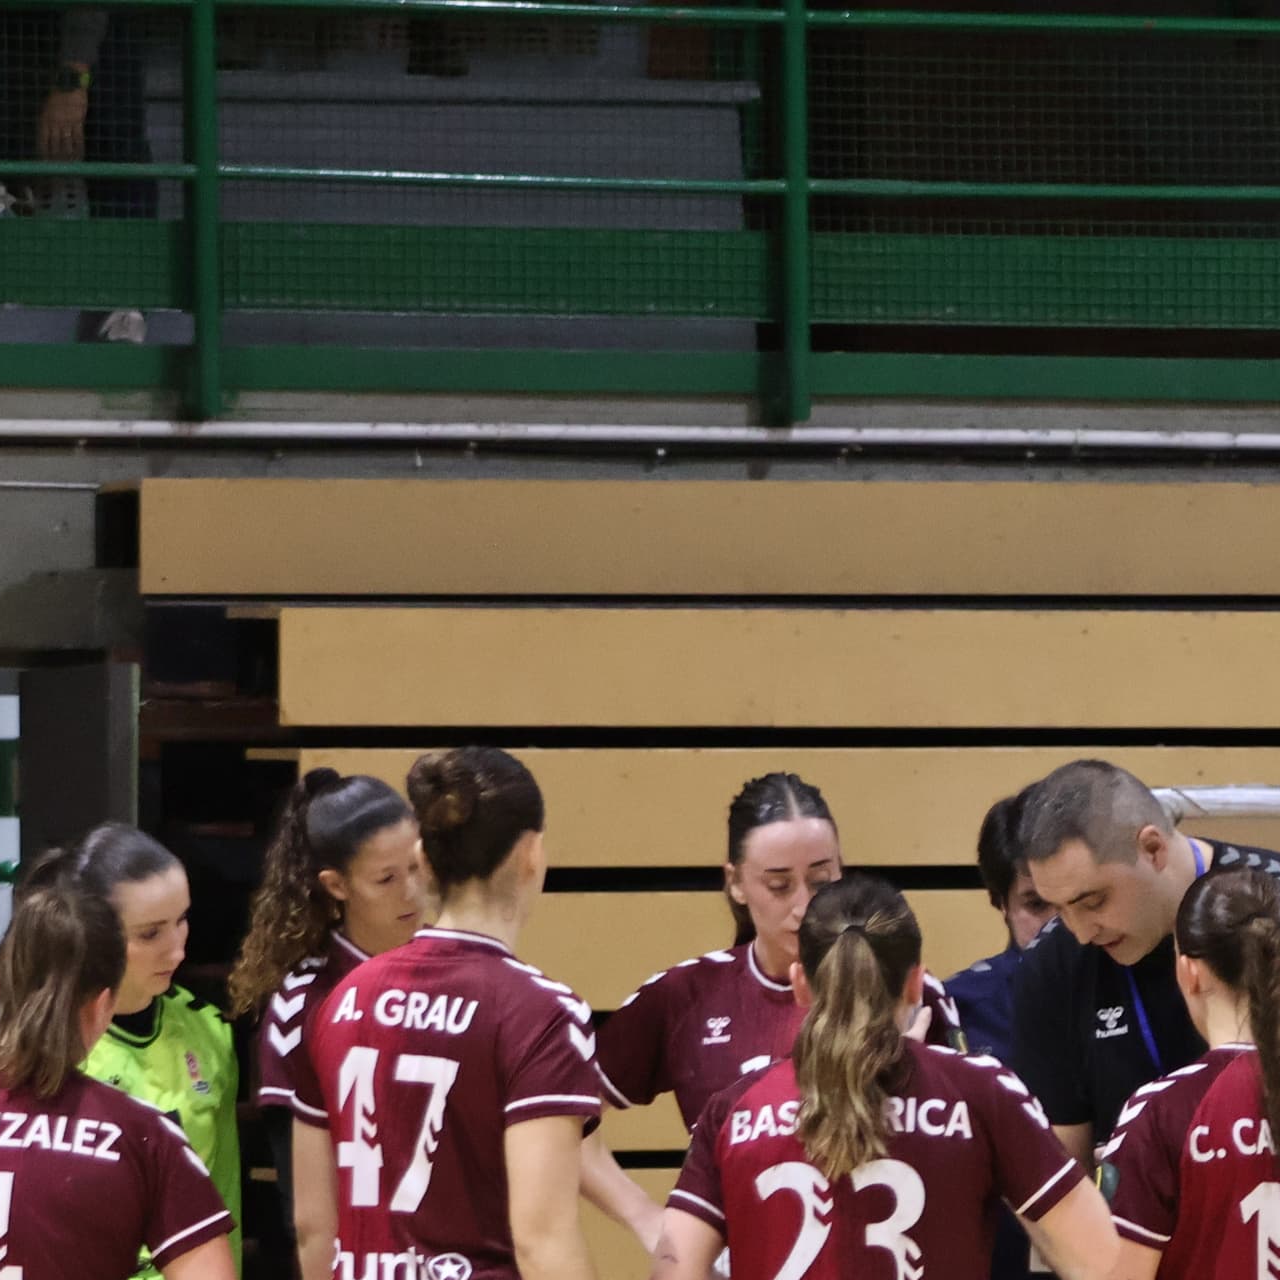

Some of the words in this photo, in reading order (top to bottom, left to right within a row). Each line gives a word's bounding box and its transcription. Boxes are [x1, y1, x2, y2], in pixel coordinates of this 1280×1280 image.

[332, 986, 364, 1024] A.
[374, 988, 479, 1035] GRAU
[337, 1045, 461, 1214] 47
[1188, 1125, 1227, 1163] C.
